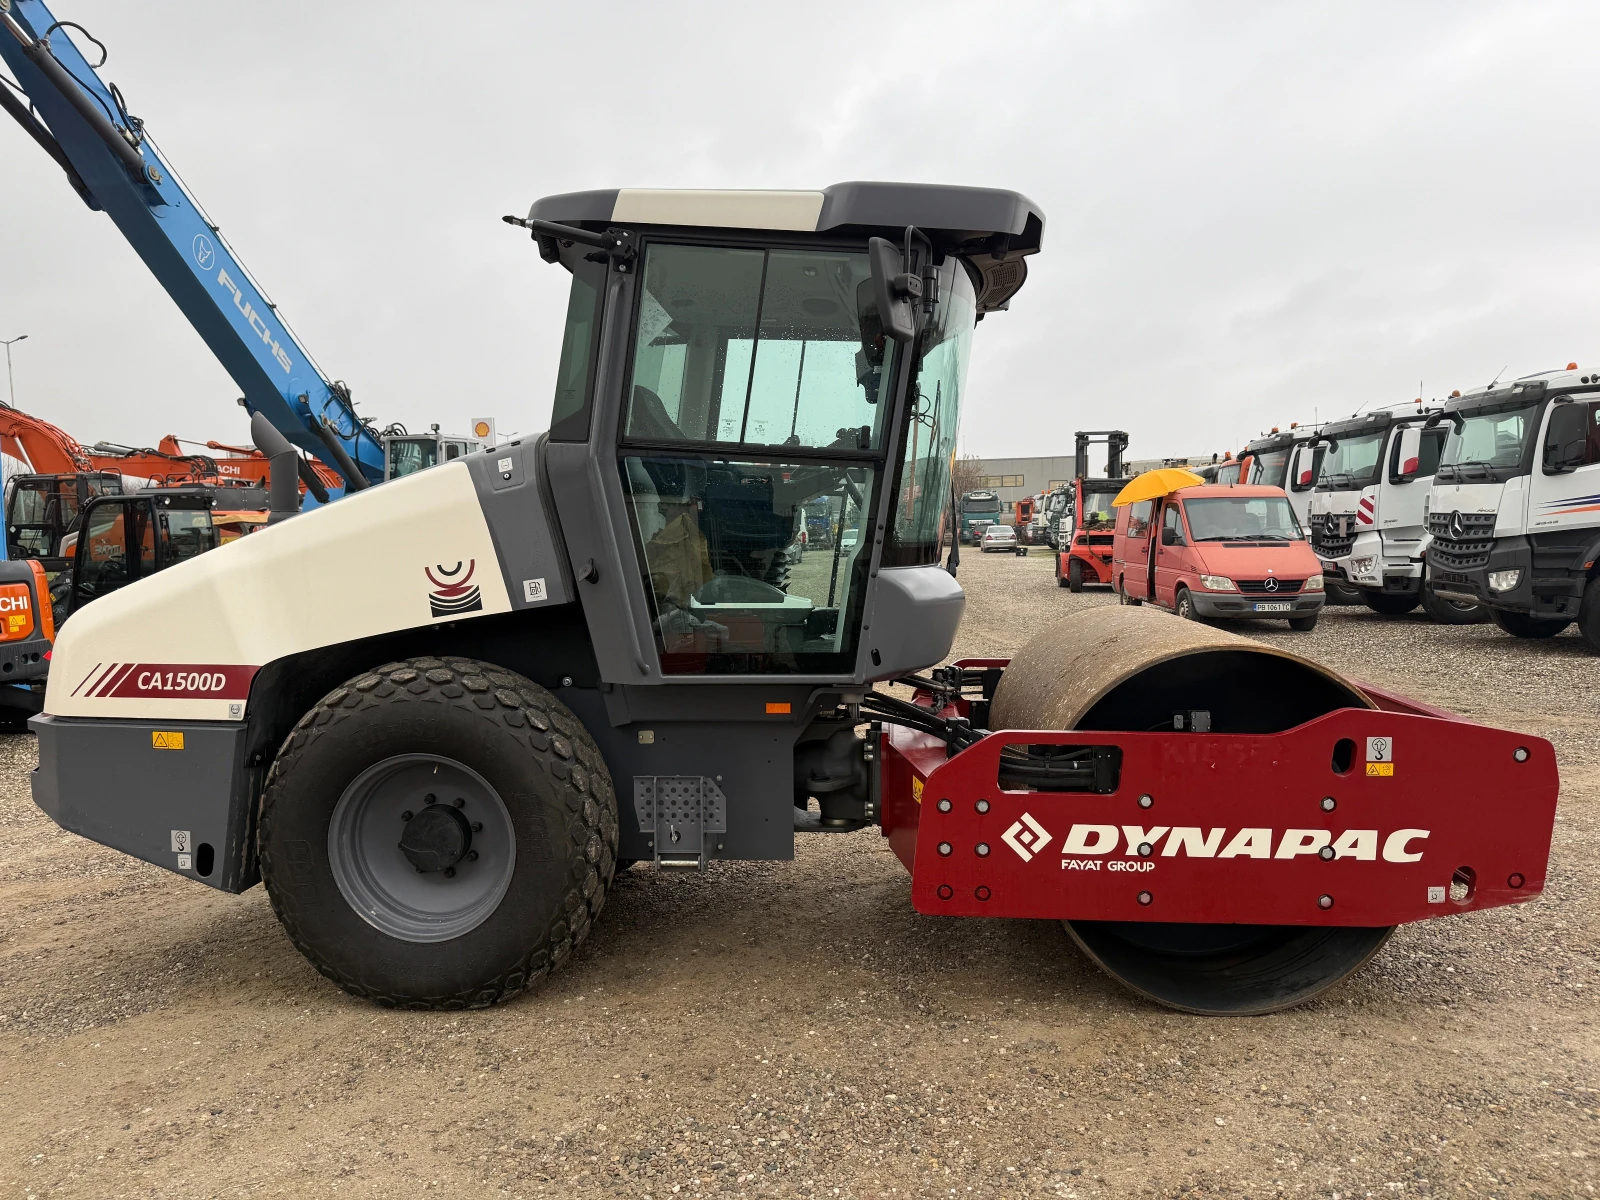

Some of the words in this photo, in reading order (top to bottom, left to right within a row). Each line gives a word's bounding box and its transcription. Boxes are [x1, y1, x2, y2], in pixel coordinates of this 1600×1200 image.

[217, 268, 293, 374] FUCHS
[0, 596, 28, 611] CHI
[137, 671, 227, 691] CA1500D
[1061, 823, 1431, 863] DYNAPAC
[1061, 859, 1103, 871] FAYAT
[1107, 860, 1156, 872] GROUP
